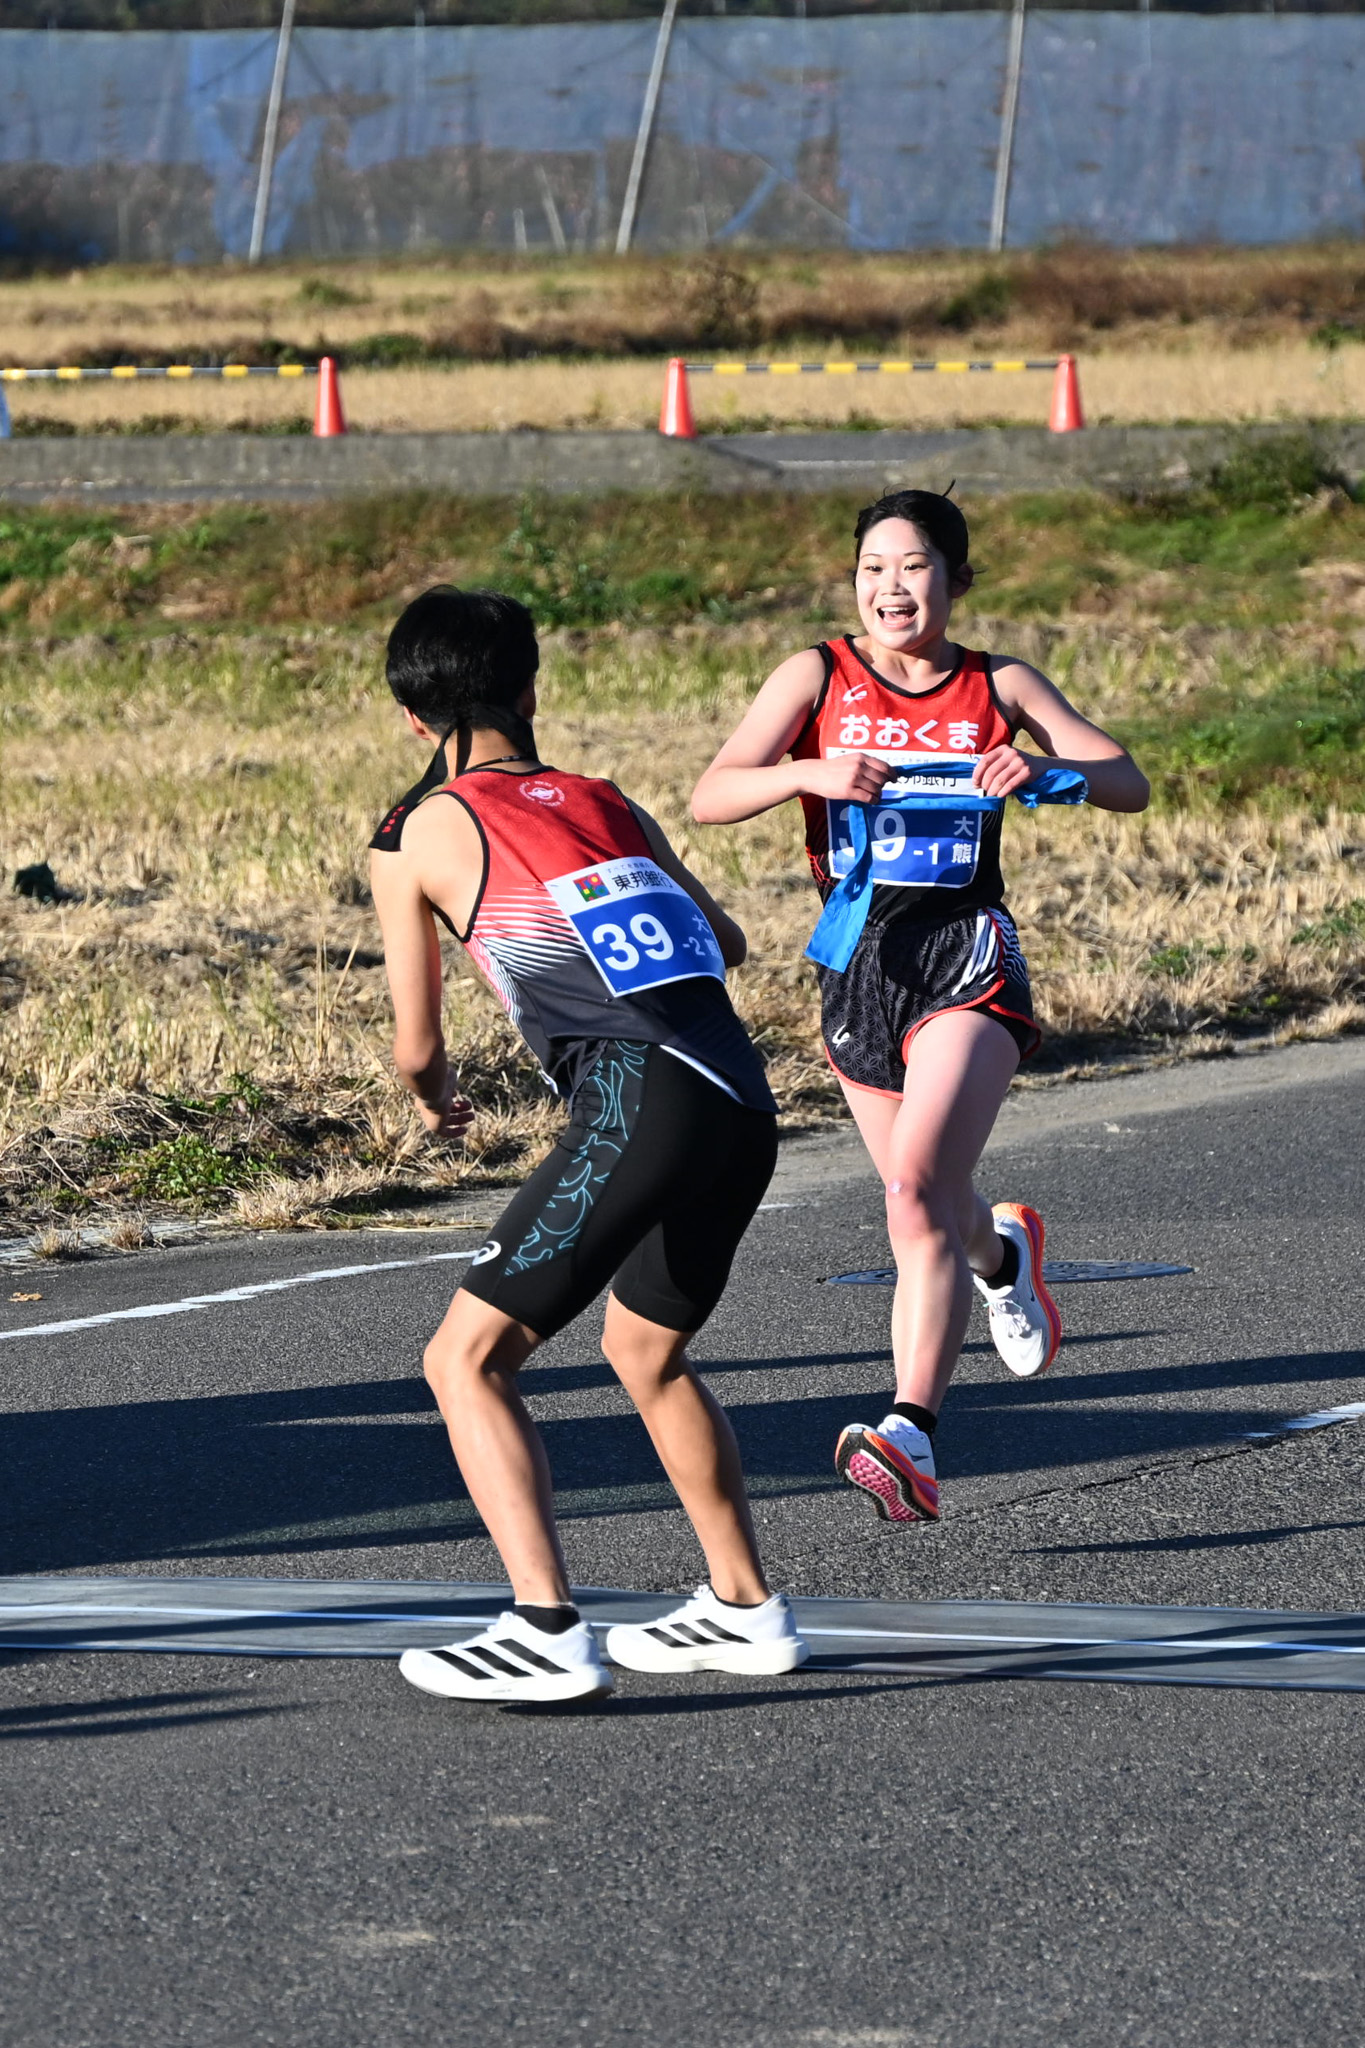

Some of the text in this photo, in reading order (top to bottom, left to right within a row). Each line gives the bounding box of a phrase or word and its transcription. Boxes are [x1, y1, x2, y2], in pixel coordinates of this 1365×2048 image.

[839, 714, 980, 750] おおくま
[951, 816, 975, 864] 大熊
[612, 869, 674, 892] 東邦銀行
